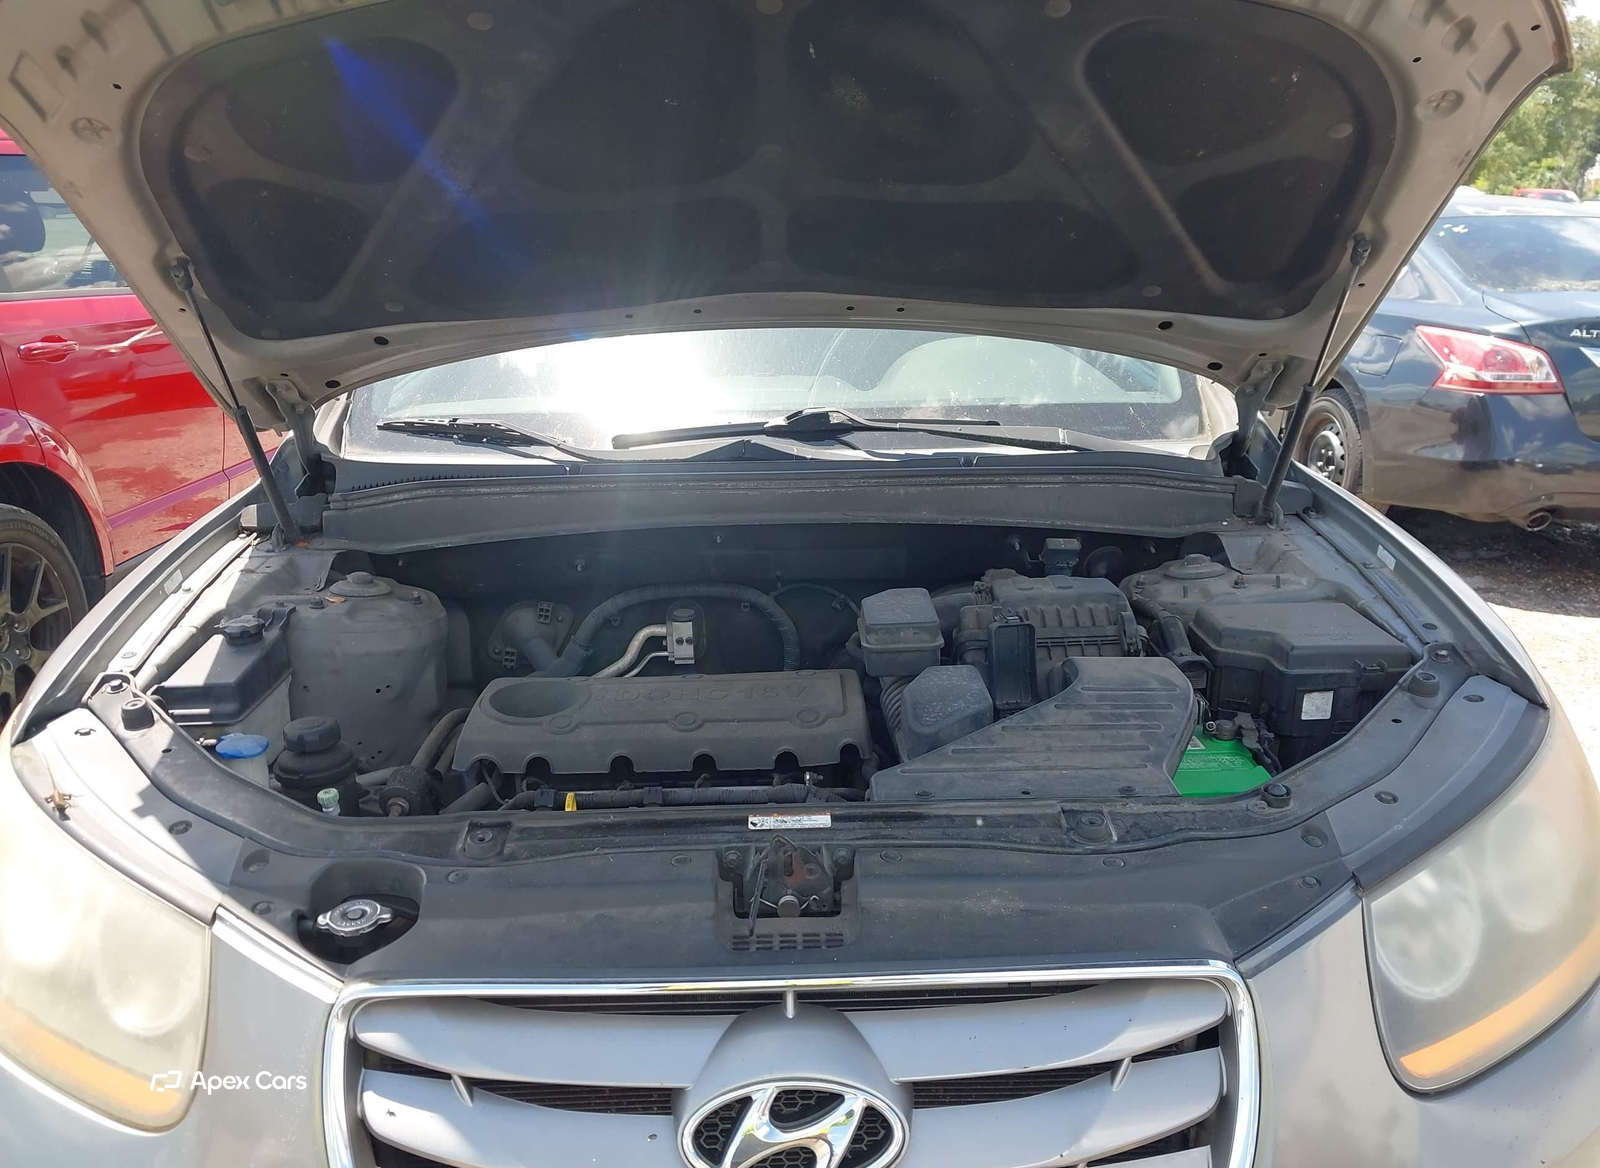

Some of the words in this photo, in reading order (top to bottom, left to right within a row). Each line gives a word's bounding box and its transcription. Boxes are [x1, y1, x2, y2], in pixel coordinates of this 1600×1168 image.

[1570, 328, 1600, 338] ALT
[613, 686, 729, 702] DOHC
[735, 683, 808, 700] 16V
